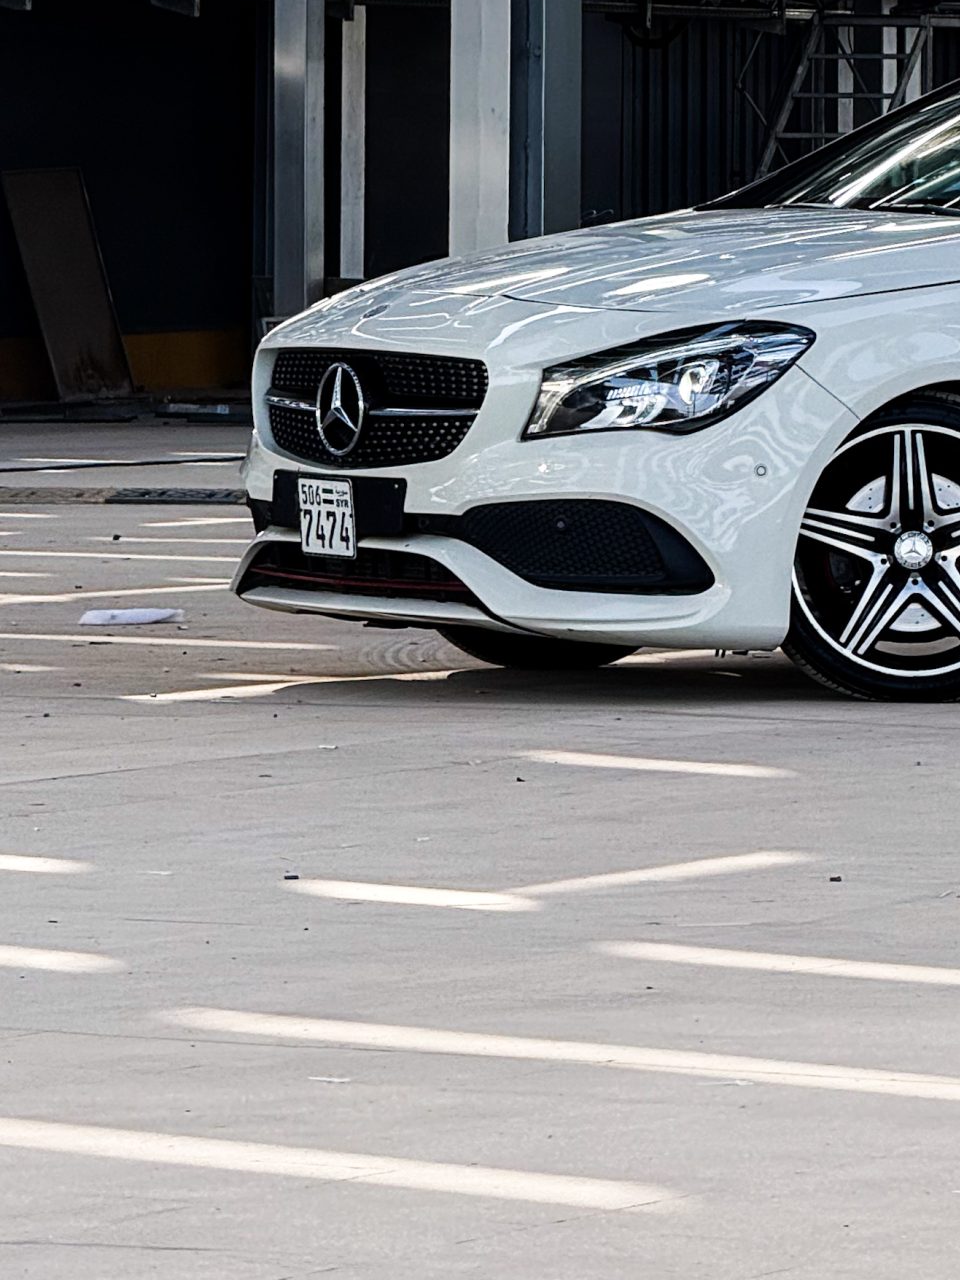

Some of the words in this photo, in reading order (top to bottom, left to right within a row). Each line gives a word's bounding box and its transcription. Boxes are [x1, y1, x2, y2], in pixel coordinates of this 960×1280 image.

[301, 484, 321, 506] 506
[336, 499, 349, 508] SYR
[303, 509, 350, 551] 7474
